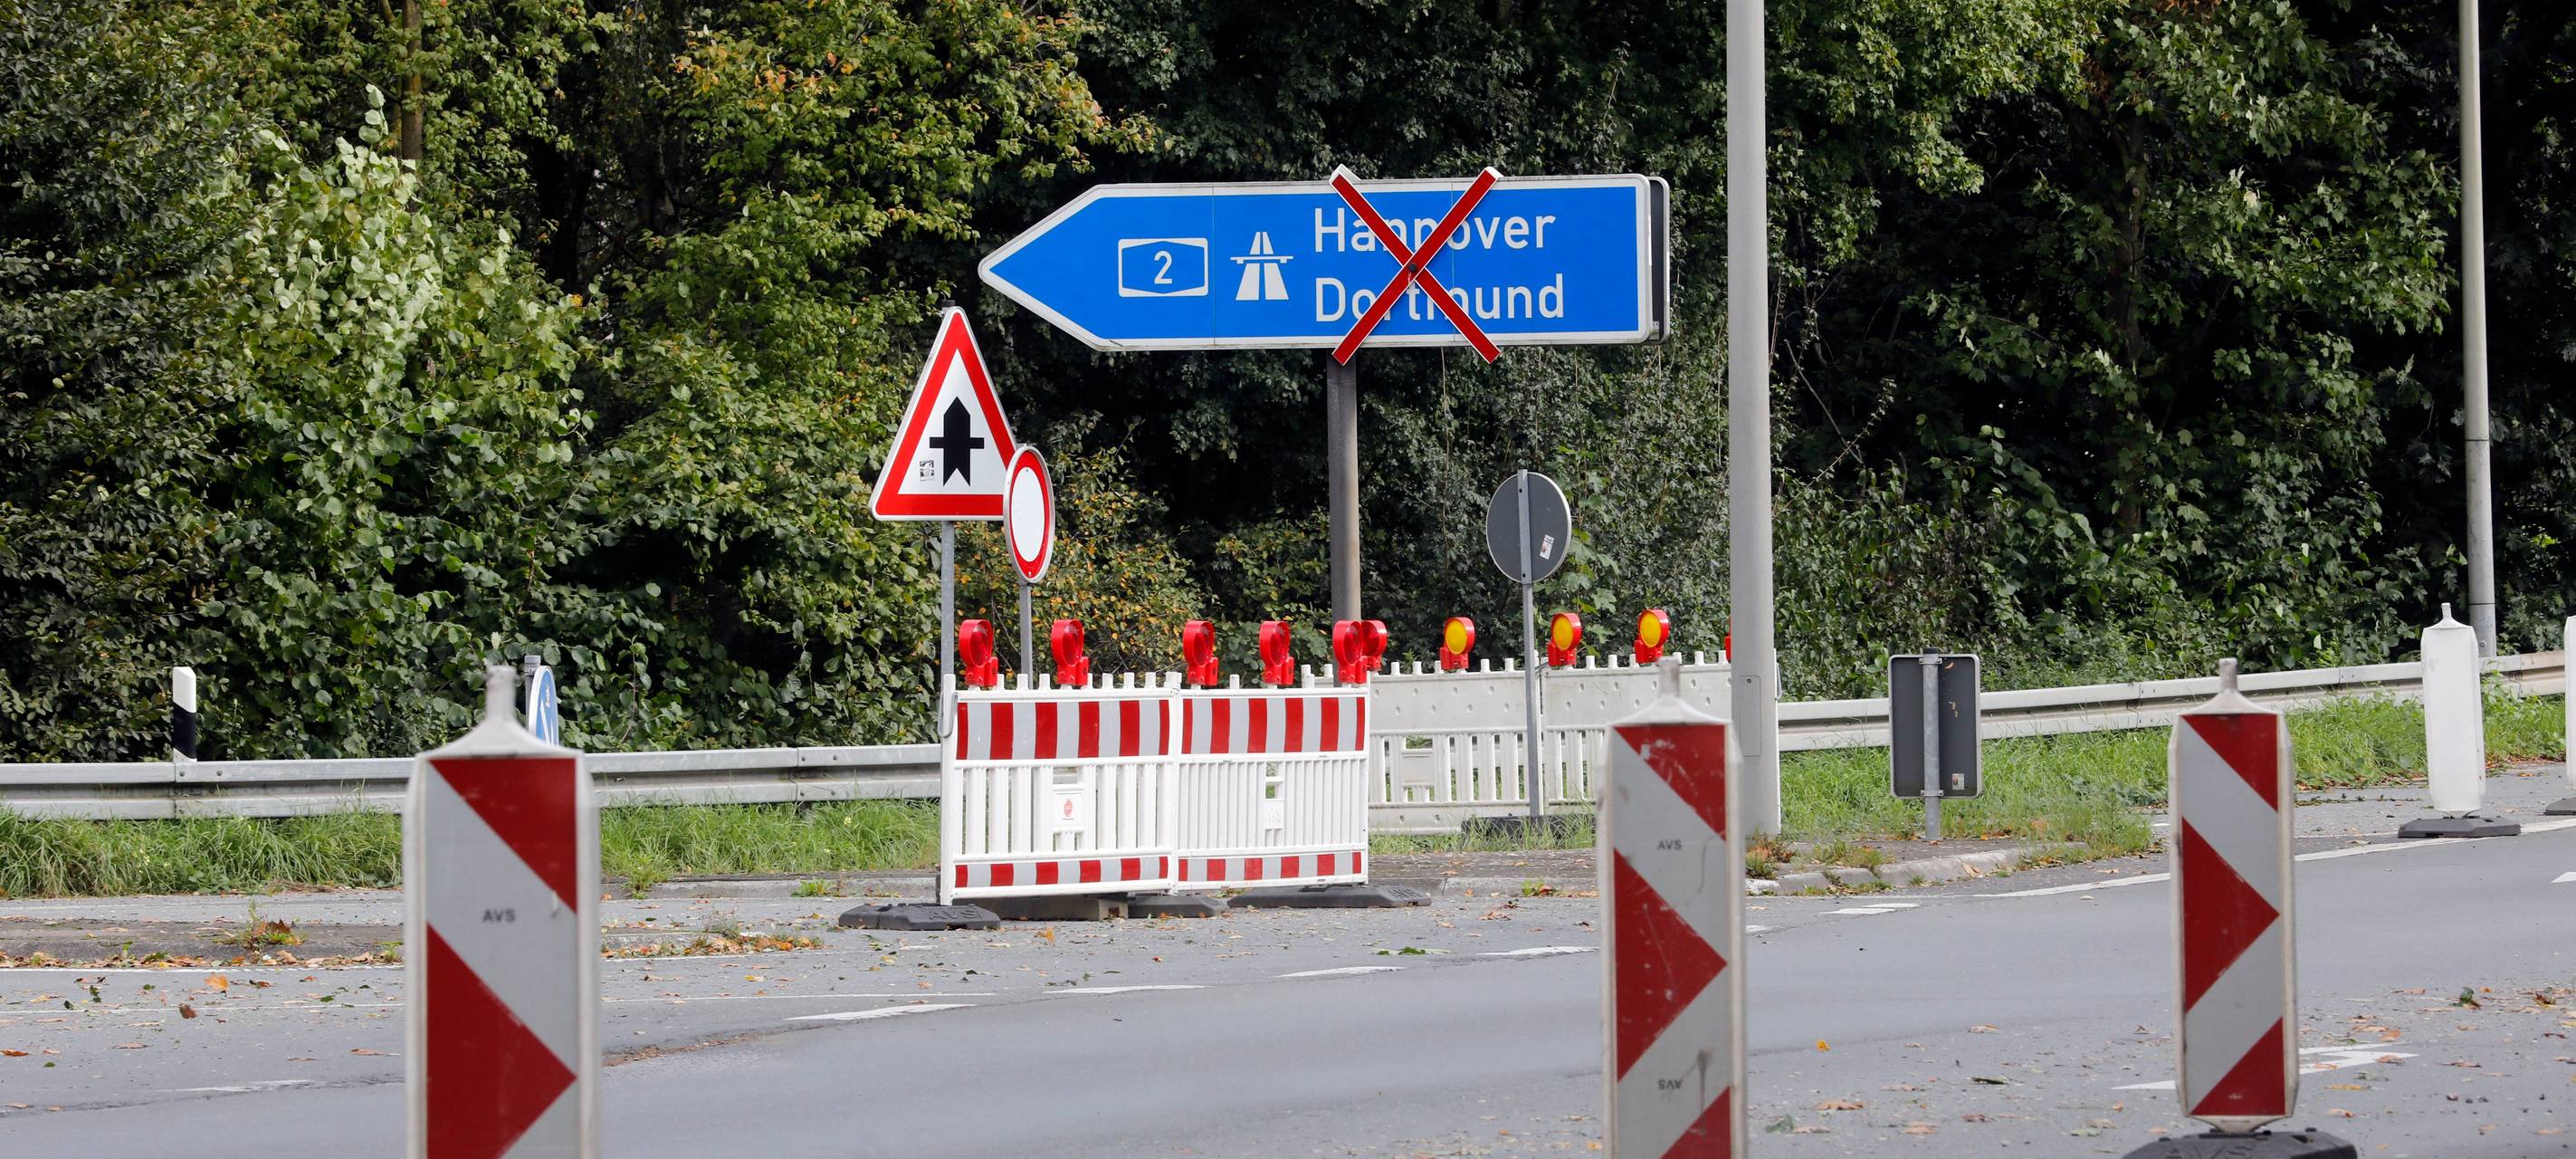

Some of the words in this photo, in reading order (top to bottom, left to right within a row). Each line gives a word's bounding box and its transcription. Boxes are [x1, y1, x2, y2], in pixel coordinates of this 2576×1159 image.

[1154, 250, 1173, 284] 2
[1315, 273, 1564, 322] Dotmund
[1657, 839, 1682, 850] AVS
[482, 908, 515, 923] AVS
[1657, 1078, 1683, 1090] AVS
